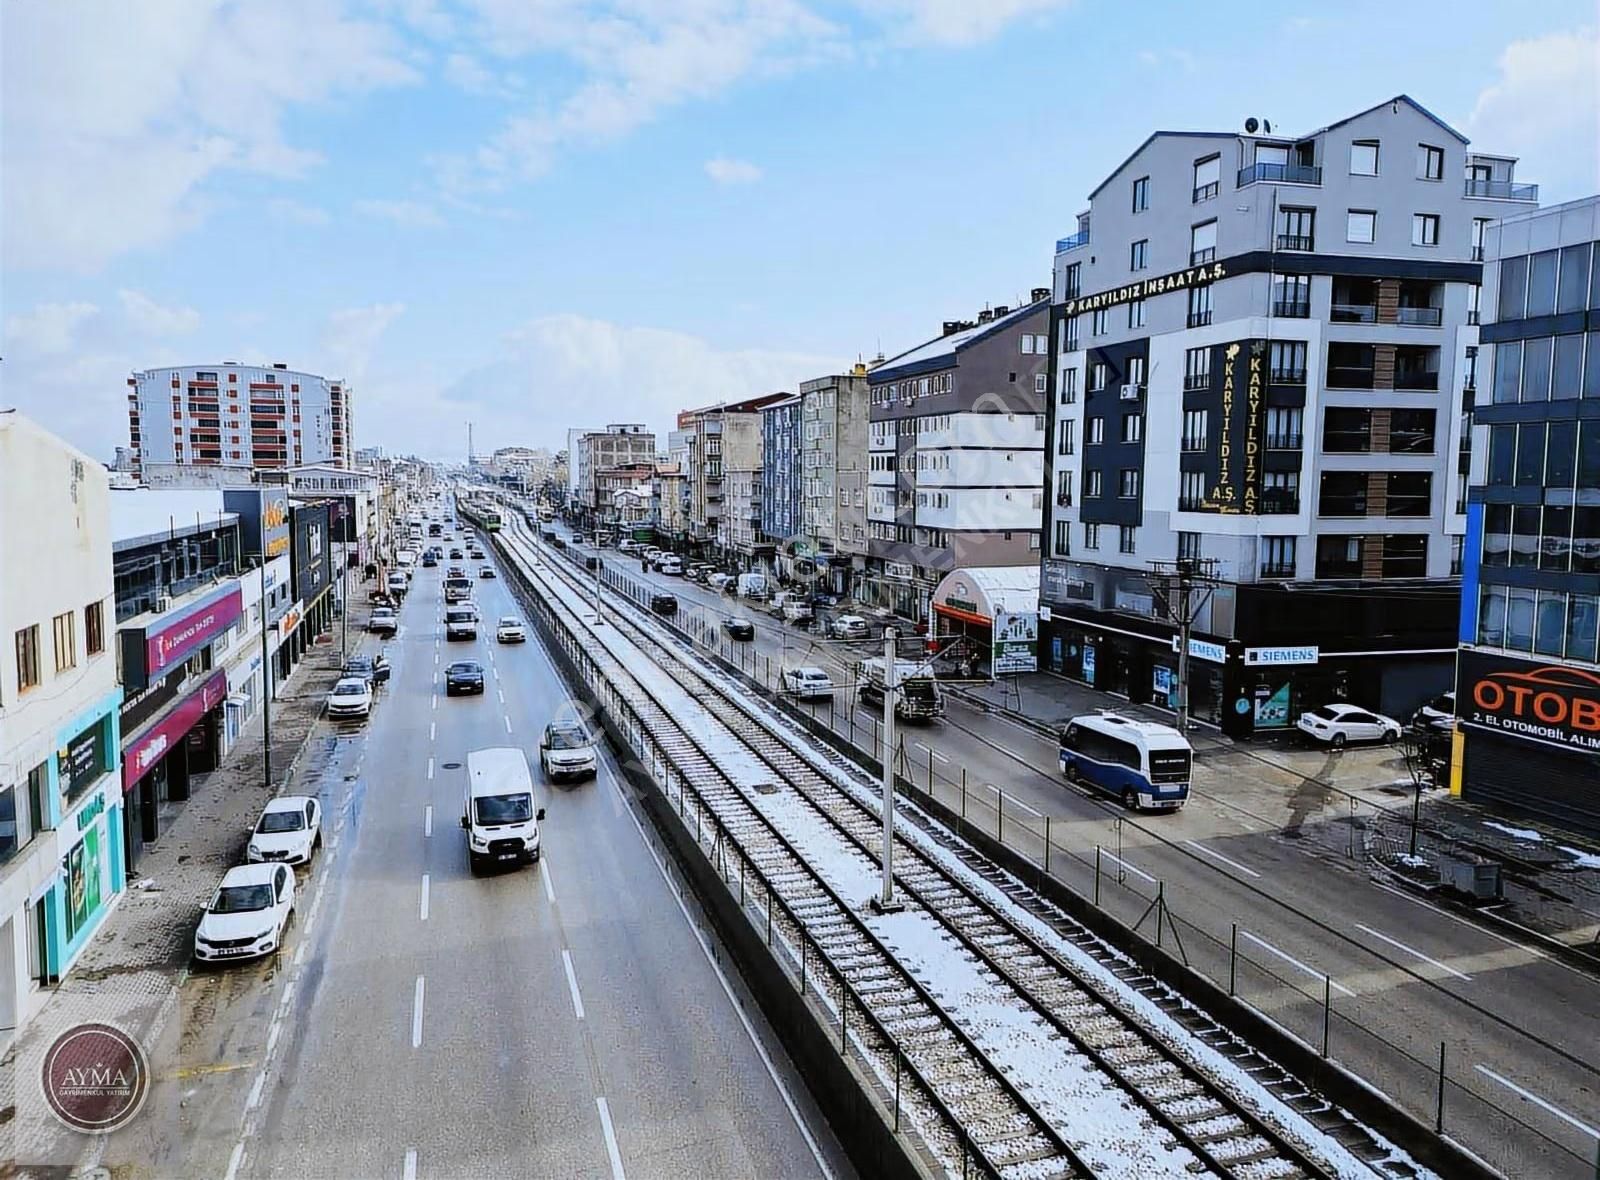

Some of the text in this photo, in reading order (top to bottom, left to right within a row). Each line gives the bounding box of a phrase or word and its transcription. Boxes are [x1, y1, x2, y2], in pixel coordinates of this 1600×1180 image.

[1078, 263, 1226, 312] KARYILDIZ İNŞAAT A.Ş.
[1220, 362, 1234, 484] KARYILDIZ
[1246, 358, 1261, 482] KARYILDIZ
[1212, 486, 1236, 502] A.Ş.
[1189, 641, 1223, 660] IEMENS
[1263, 650, 1314, 661] SIEMENS
[1473, 680, 1600, 732] OTOB
[1473, 712, 1483, 722] 2.
[1485, 715, 1500, 726] EL
[1502, 718, 1568, 741] OTOMOBİL
